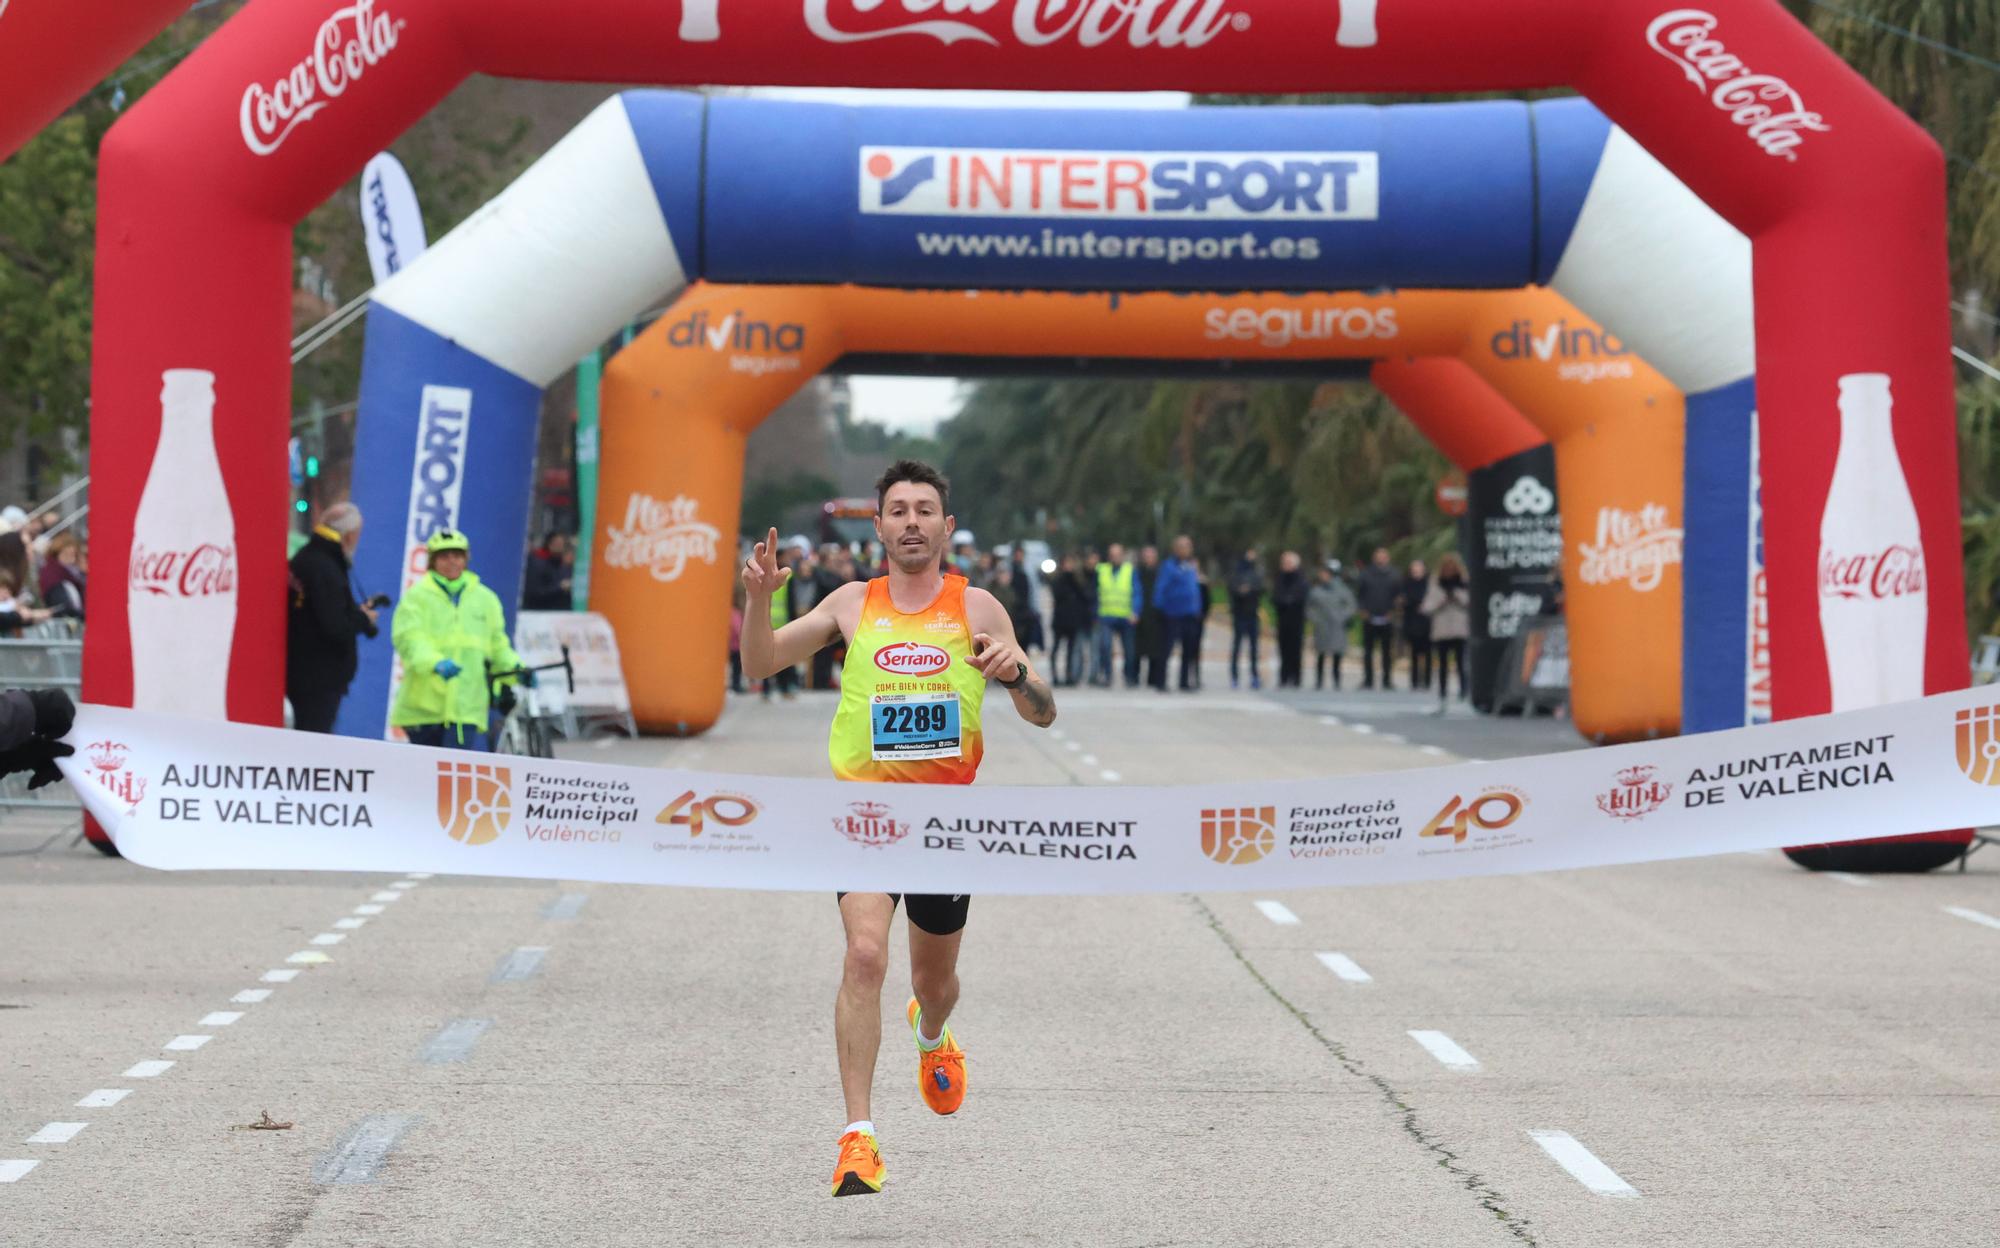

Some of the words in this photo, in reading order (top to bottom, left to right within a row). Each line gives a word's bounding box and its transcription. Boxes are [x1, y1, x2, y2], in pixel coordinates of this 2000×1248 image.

[947, 155, 1358, 213] INTERSPORT
[917, 229, 1320, 263] www.intersport.es
[668, 310, 805, 352] divina
[1204, 307, 1398, 347] seguros
[1557, 361, 1633, 384] seguros
[1486, 530, 1563, 549] TRINIDA
[1578, 527, 1683, 592] detenga
[881, 651, 944, 666] Serrano
[876, 683, 897, 692] COME
[899, 682, 917, 691] BIEN
[920, 683, 925, 691] Y
[927, 682, 951, 692] CORRE
[882, 704, 947, 733] 2289
[1687, 735, 1895, 785] AJUNTAMENT
[161, 764, 375, 793] AJUNTAMENT
[525, 773, 630, 792] Fundació
[1684, 786, 1725, 808] DE
[1738, 761, 1894, 800] VALÈNCIA
[525, 786, 635, 805] Esportiva
[160, 798, 200, 820] DE
[215, 797, 373, 828] VALÈNCIA
[525, 804, 639, 826] Municipal
[655, 790, 758, 838] 40
[1289, 799, 1396, 819] Fundació
[1418, 793, 1523, 844] 40
[525, 824, 622, 843] València
[924, 817, 1138, 838] AJUNTAMENT
[1289, 815, 1400, 833] Esportiva
[924, 835, 965, 851] DE
[978, 839, 1137, 860] VALÈNCIA
[1289, 827, 1402, 846] Municipal
[1290, 845, 1386, 859] València
